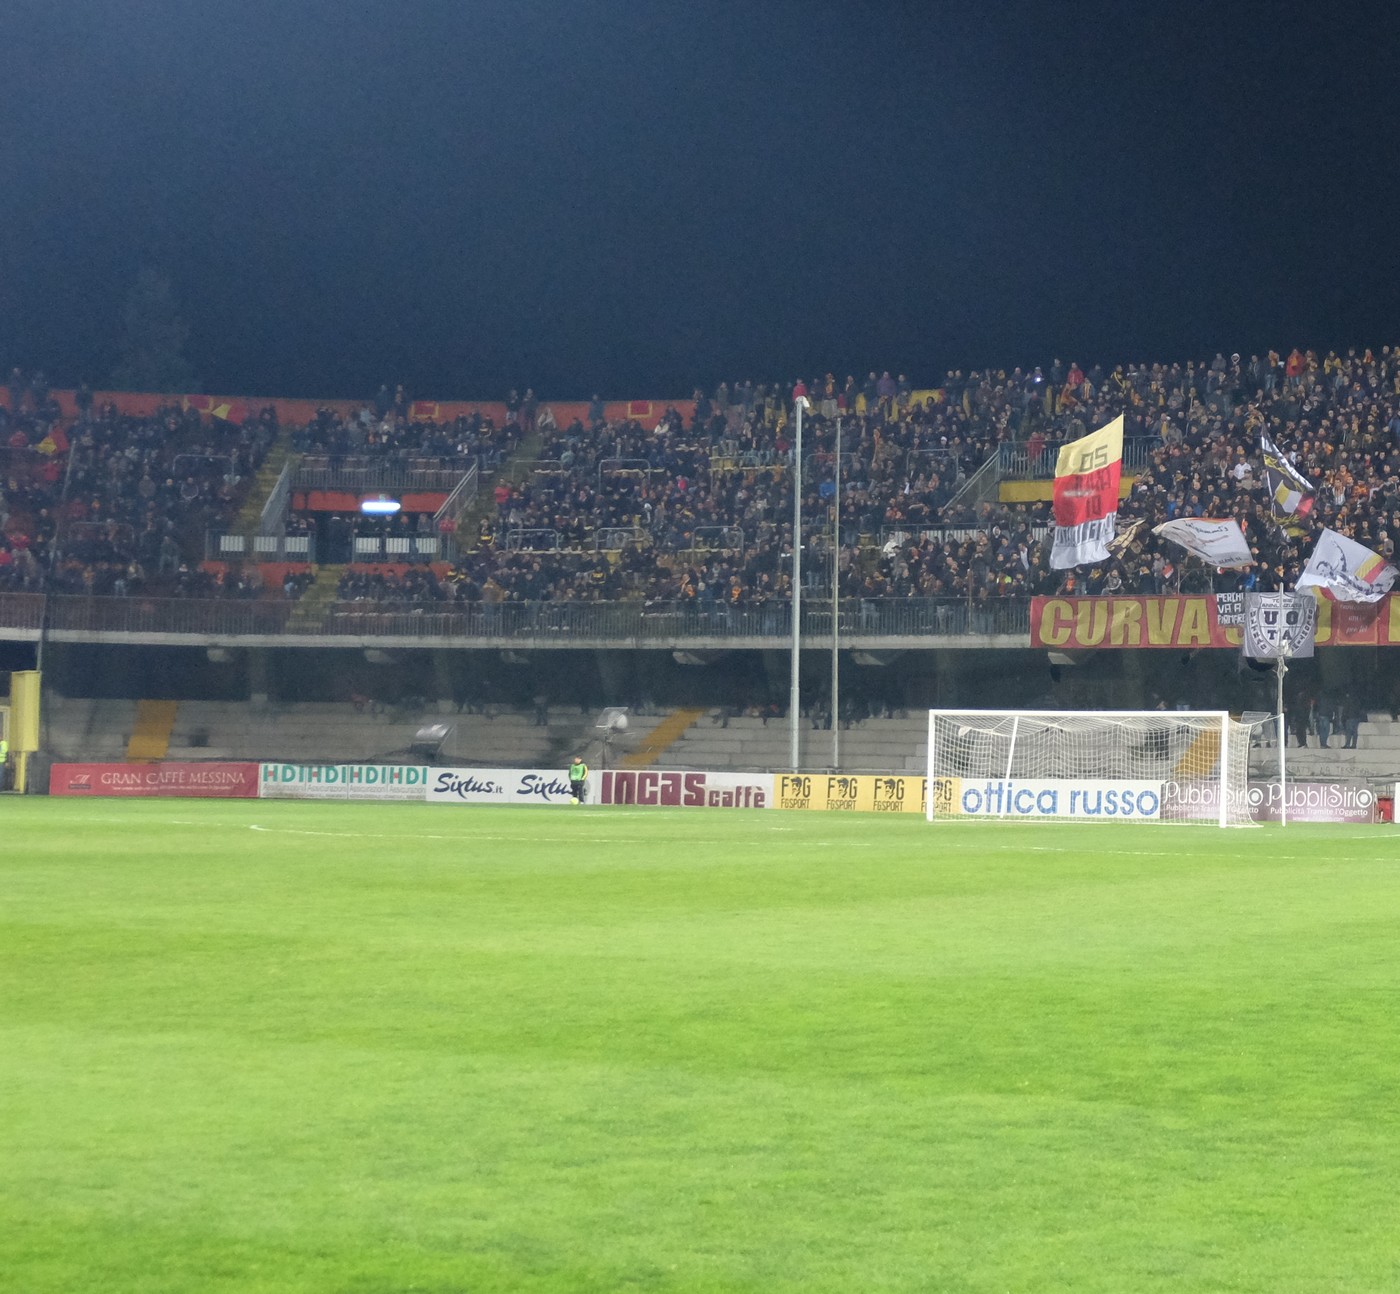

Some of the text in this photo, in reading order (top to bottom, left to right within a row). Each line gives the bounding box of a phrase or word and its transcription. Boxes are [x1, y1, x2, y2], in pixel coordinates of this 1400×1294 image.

[1039, 598, 1211, 645] CURVA
[101, 769, 245, 784] GRAN CAFFÈ MESSINA
[263, 764, 304, 782] HDI
[308, 765, 346, 783] HDI
[350, 766, 386, 784] HDI
[390, 767, 427, 784] HDI
[963, 782, 1160, 816] ottica russo
[1265, 783, 1373, 808] PubbliSirio
